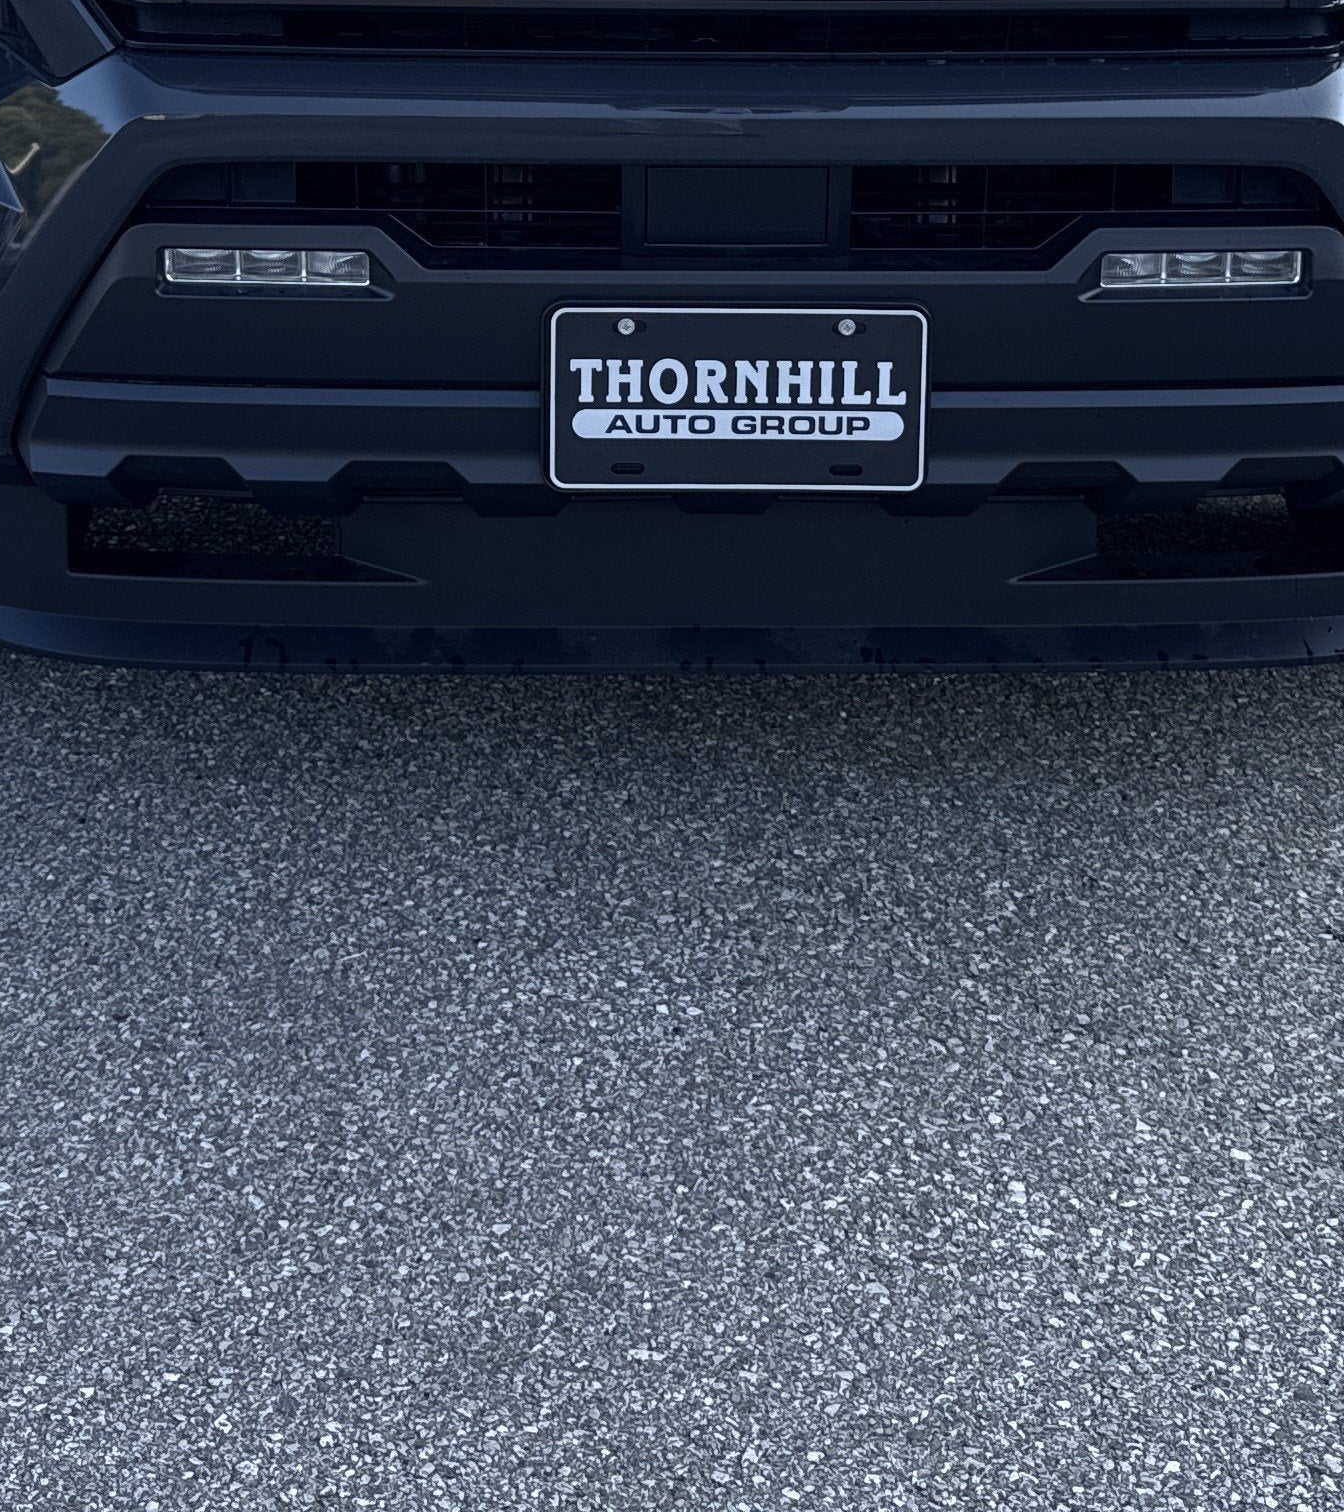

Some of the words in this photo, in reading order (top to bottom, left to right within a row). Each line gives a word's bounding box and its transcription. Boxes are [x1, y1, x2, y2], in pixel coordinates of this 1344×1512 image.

[569, 358, 907, 406] THORNHILL
[604, 414, 716, 435] AUTO
[731, 414, 871, 436] GROUP
